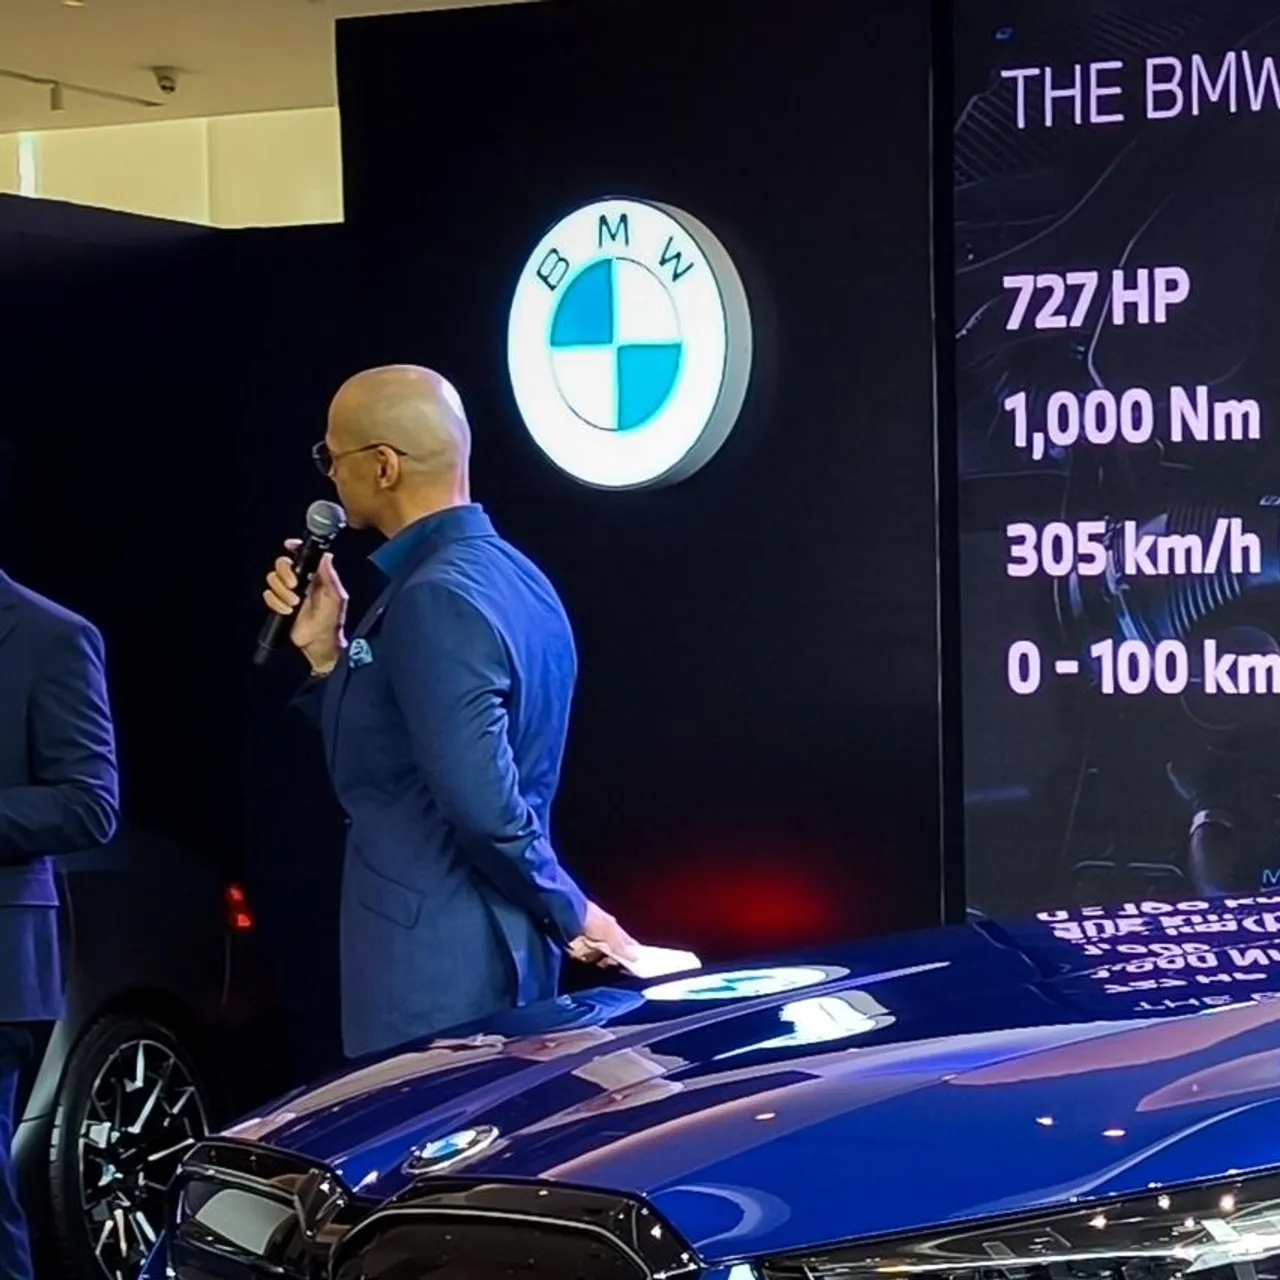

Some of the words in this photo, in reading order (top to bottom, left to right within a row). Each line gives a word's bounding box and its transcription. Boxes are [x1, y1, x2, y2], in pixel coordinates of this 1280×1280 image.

[1000, 61, 1124, 129] THE
[536, 213, 694, 291] BMW
[1002, 271, 1099, 330] 727
[1111, 266, 1190, 325] HP
[1004, 388, 1154, 460] 1,000
[1170, 385, 1261, 442] Nm
[1006, 520, 1107, 577] 305
[1124, 516, 1262, 575] km/h
[1008, 640, 1041, 694] 0
[1090, 638, 1189, 694] 100
